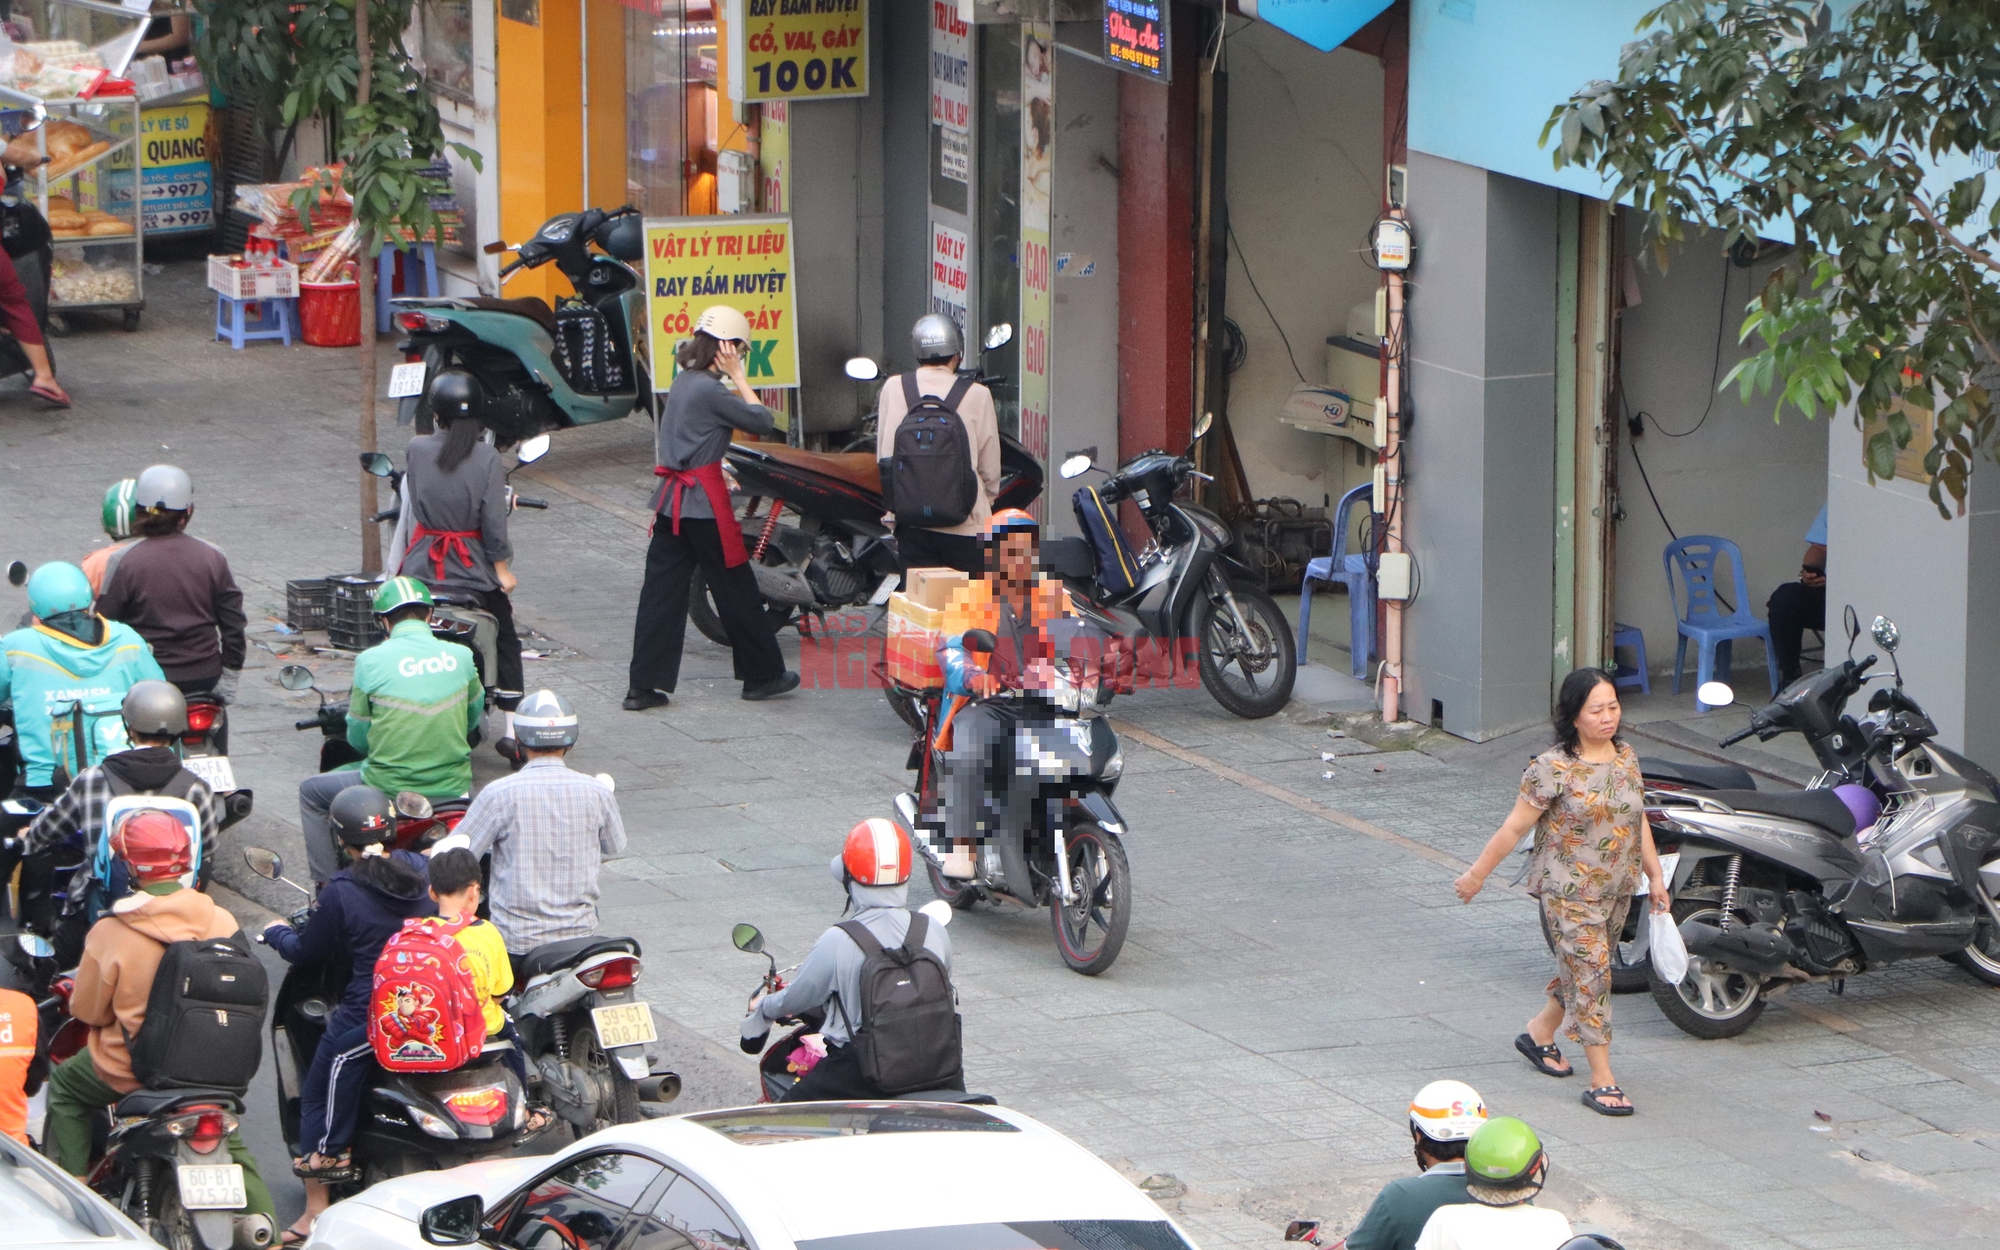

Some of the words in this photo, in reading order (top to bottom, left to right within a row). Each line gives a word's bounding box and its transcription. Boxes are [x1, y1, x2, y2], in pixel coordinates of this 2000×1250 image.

[784, 31, 816, 54] VAI,
[822, 23, 861, 50] GÁY
[752, 56, 857, 93] 100K
[148, 136, 205, 164] QUANG
[167, 183, 198, 198] 997
[178, 210, 211, 225] 997
[653, 232, 688, 264] VẬT
[690, 230, 713, 258] LÝ
[716, 235, 744, 262] TRỊ
[747, 228, 786, 261] LIỆU
[936, 231, 953, 261] VẬT
[953, 236, 966, 262] LÝ
[655, 276, 689, 298] RAY
[691, 265, 729, 297] BẤM
[732, 268, 787, 300] HUYỆT
[933, 261, 947, 290] TRỊ
[947, 265, 968, 295] LIỆU
[1025, 240, 1048, 301] CẠO
[1026, 319, 1046, 377] GIÓ
[398, 650, 458, 678] Grab
[601, 1006, 642, 1026] 59-G1
[189, 1168, 233, 1187] 60-B1
[186, 1186, 244, 1206] 125.26
